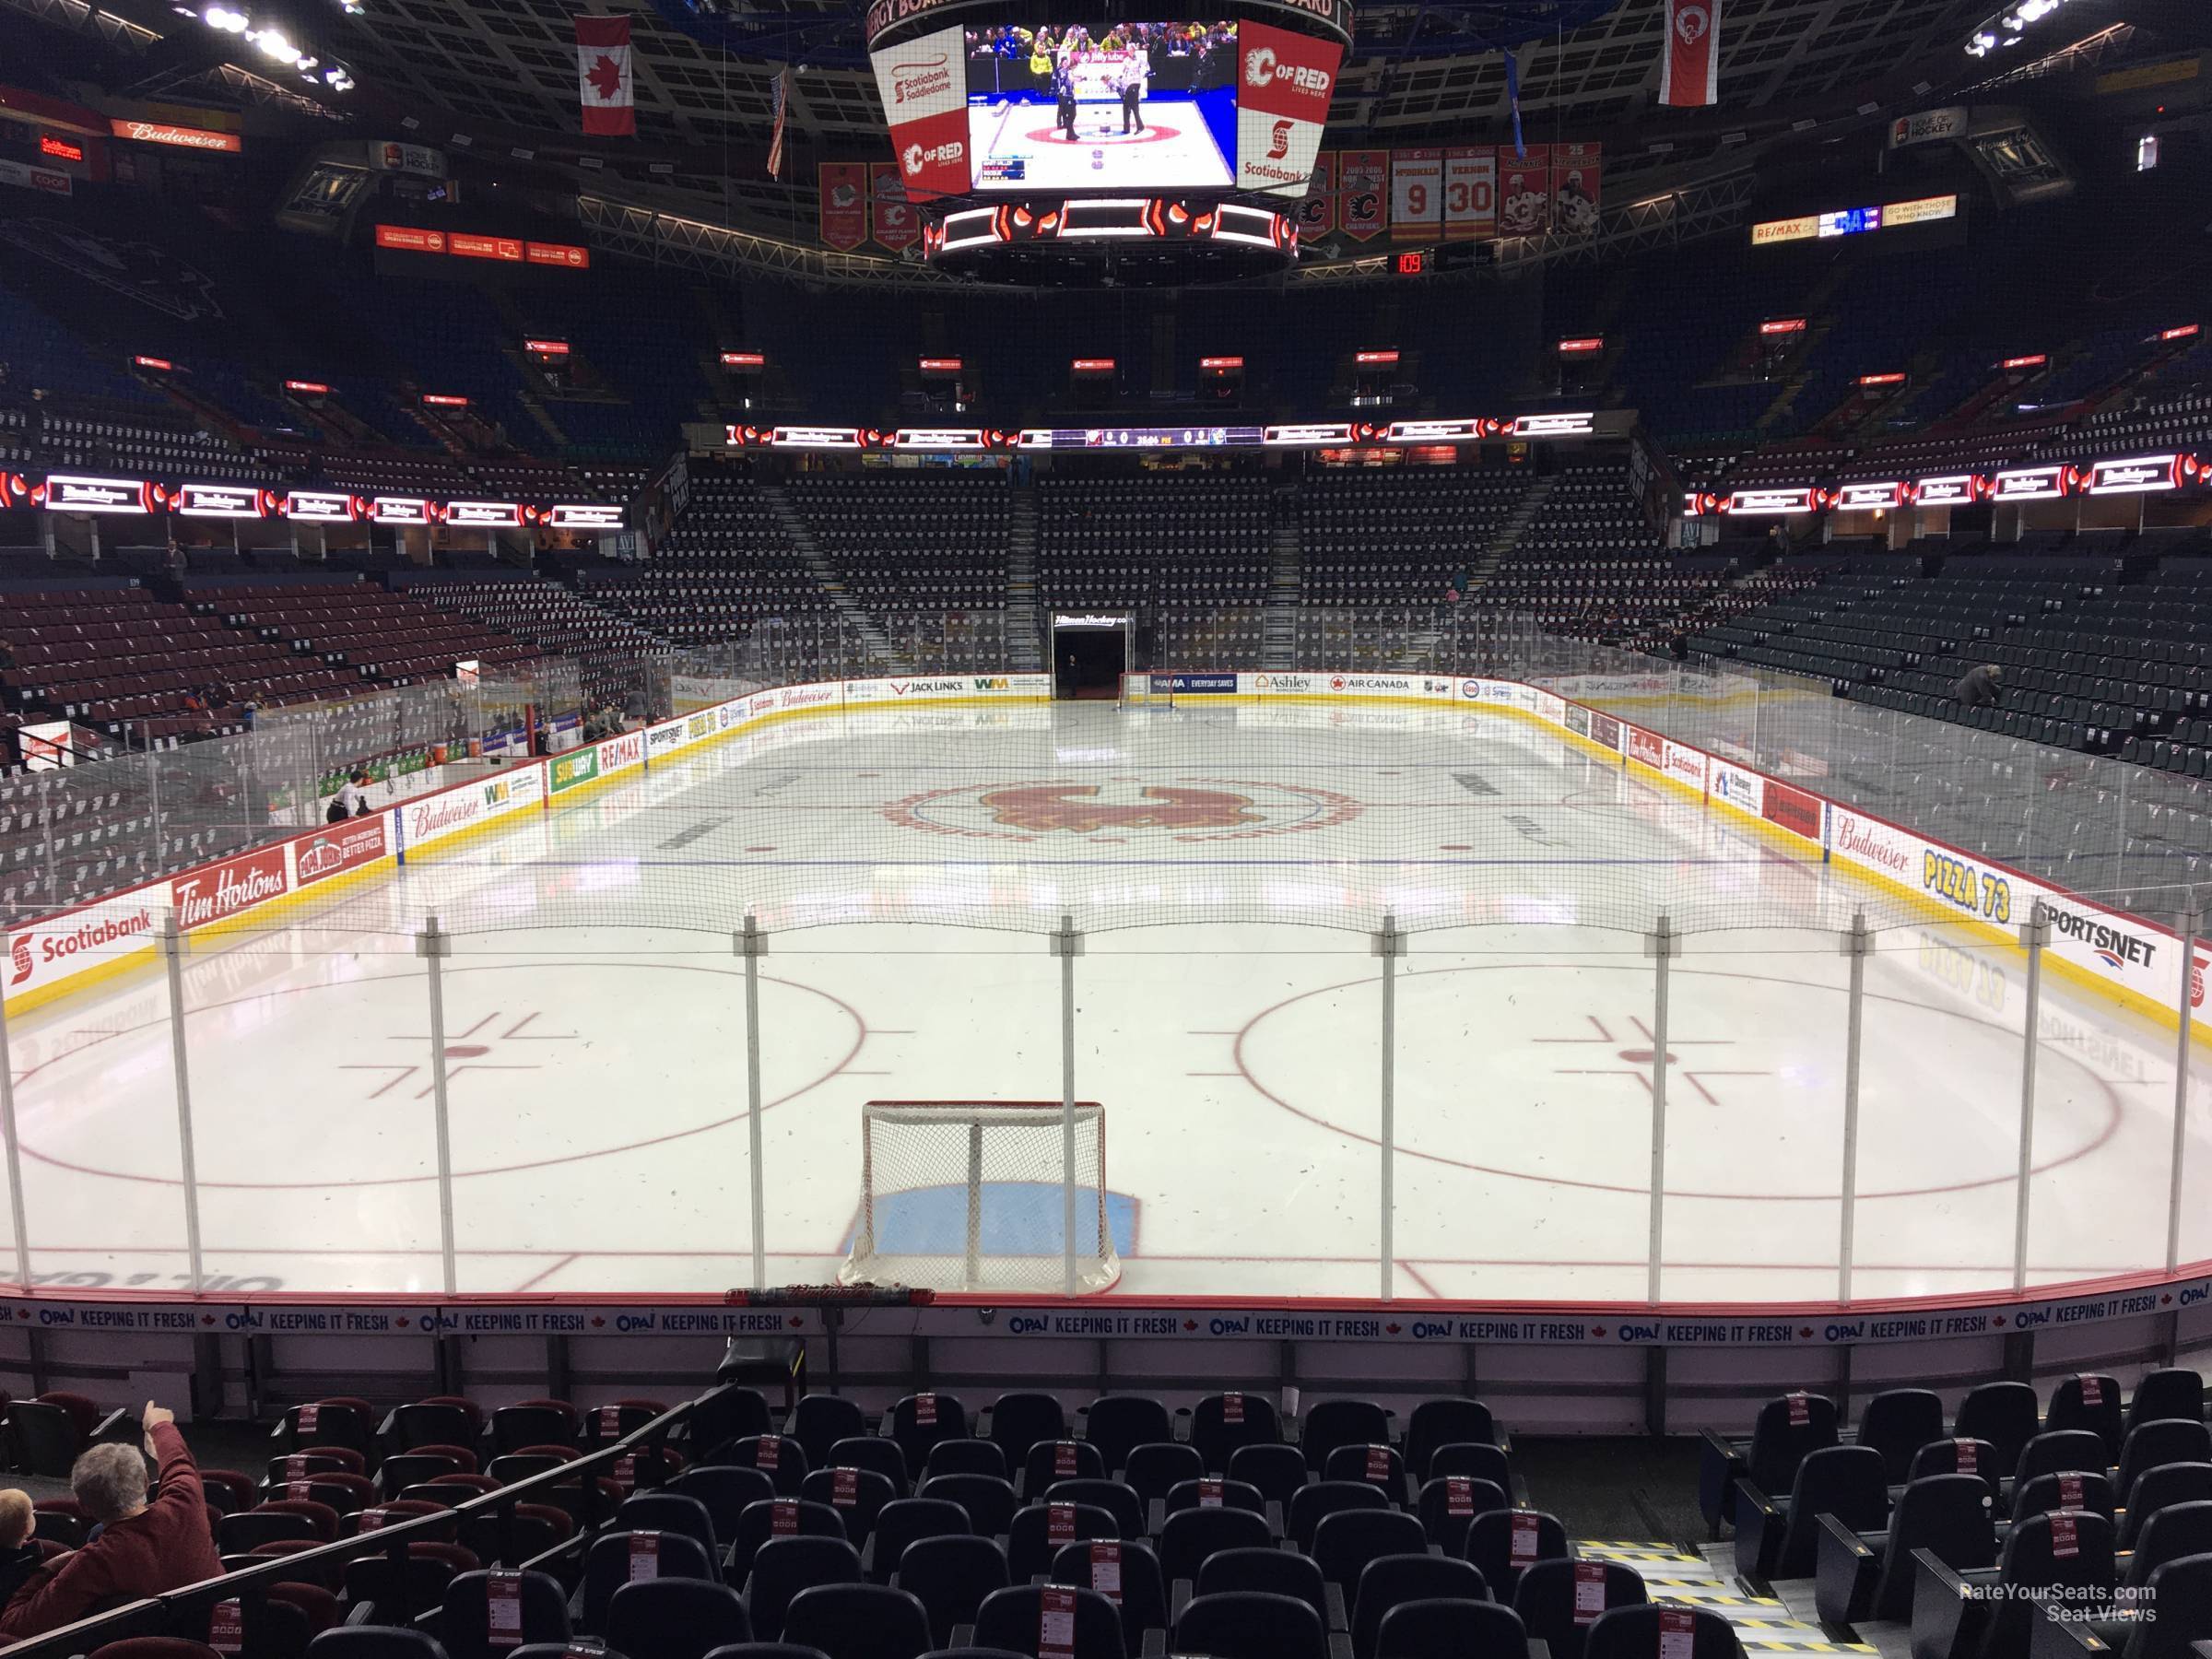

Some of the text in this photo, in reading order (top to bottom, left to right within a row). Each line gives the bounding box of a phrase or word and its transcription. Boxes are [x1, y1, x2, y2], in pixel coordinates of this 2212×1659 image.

[904, 67, 950, 89] Scotiabank
[1276, 64, 1294, 79] OF
[1294, 65, 1330, 91] RED
[906, 81, 951, 100] Saddledome
[1292, 86, 1309, 95] LIVES
[127, 122, 227, 148] Budweiser
[1912, 123, 1952, 138] HOCKEY
[924, 148, 937, 162] OF
[937, 141, 963, 160] RED
[1244, 161, 1302, 182] Scotiabank
[1408, 184, 1427, 215] 9
[1448, 182, 1491, 212] 30
[1900, 203, 1924, 214] WITH
[1924, 199, 1951, 209] THOSE
[1896, 209, 1942, 220] WHO KNOW
[1757, 224, 1801, 239] RE/MAX
[911, 681, 963, 692] JACK LINK'S
[975, 678, 1009, 689] WM
[1192, 679, 1217, 688] EVERYDAY
[1218, 679, 1233, 688] SAVES
[1269, 676, 1311, 689] Ashley
[1347, 679, 1409, 689] AIR CANADA
[782, 688, 832, 707] Budweiser
[650, 724, 683, 745] SPORTSNET
[602, 737, 640, 771] RE/MAX
[556, 752, 594, 783] SUBWAY
[1672, 753, 1701, 778] Scotiabank
[484, 782, 509, 806] WM
[412, 799, 479, 839] Budweiser
[343, 842, 365, 859] BETTER
[1838, 814, 1909, 871] Budweiser
[300, 847, 320, 877] PAPA
[176, 867, 283, 927] Tim Hortons
[1924, 849, 2010, 924] PIZZA 73
[42, 909, 151, 962] Scotiabank
[2180, 1283, 2209, 1306] OPA!
[40, 1309, 195, 1328] OPA! KEEPING IT FRESH
[270, 1313, 325, 1330] KEEPING
[330, 1313, 343, 1329] IT
[347, 1313, 388, 1330] FRESH
[465, 1314, 522, 1330] KEEPING
[525, 1314, 538, 1330] IT
[543, 1314, 584, 1330] FRESH
[617, 1309, 782, 1332] OPA! KEEPING IT FRESH
[2015, 1295, 2156, 1328] OPA! KEEPING IT FRESH
[1009, 1316, 1177, 1335] OPA! KEEPING IT FRESH
[1210, 1317, 1380, 1336] OPA! KEEPING IT FRESH
[1412, 1321, 1584, 1340] OPA! KEEPING IT FRESH
[1618, 1324, 1792, 1342] OPA! KEEPING IT FRESH
[1825, 1316, 1987, 1342] OPA! KEEPING IT FRESH
